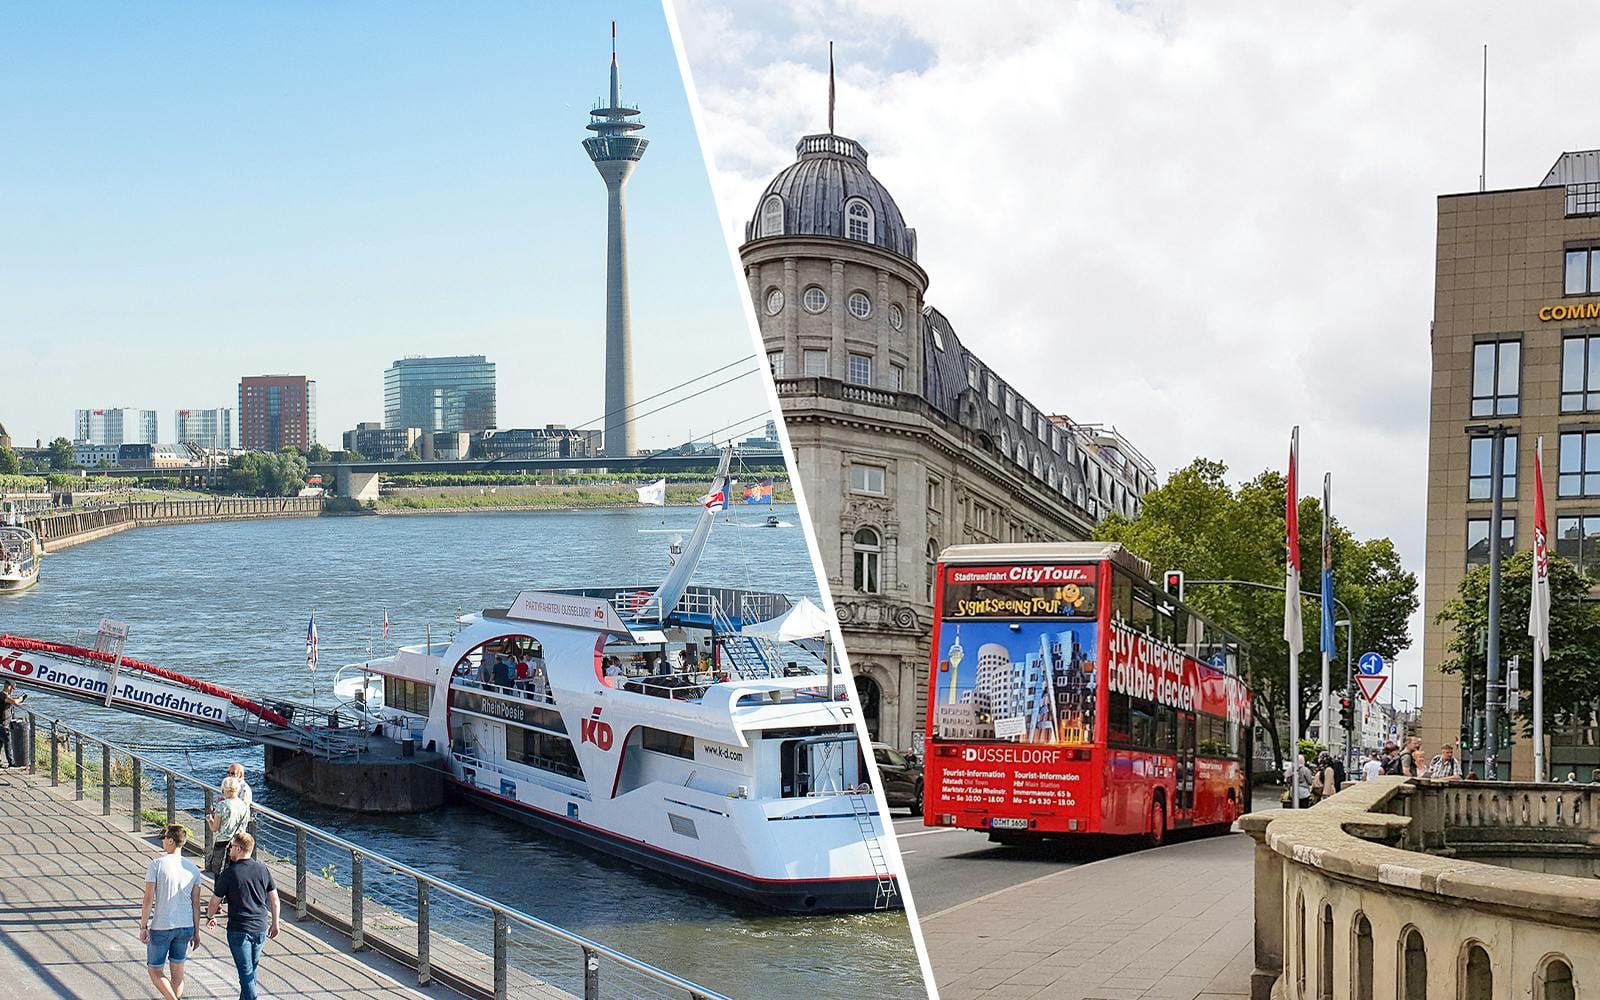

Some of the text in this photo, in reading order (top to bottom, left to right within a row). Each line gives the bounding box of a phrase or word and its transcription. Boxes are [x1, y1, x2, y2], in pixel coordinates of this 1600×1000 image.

[1538, 303, 1600, 321] COMM
[954, 572, 1007, 582] Stadtrundfahrt
[1138, 624, 1185, 677] checker
[1157, 660, 1195, 712] decker
[581, 706, 614, 752] KD
[703, 744, 743, 762] www.k-d.com
[942, 768, 1006, 778] Tourist-Information
[1014, 770, 1080, 781] Tourist-Information
